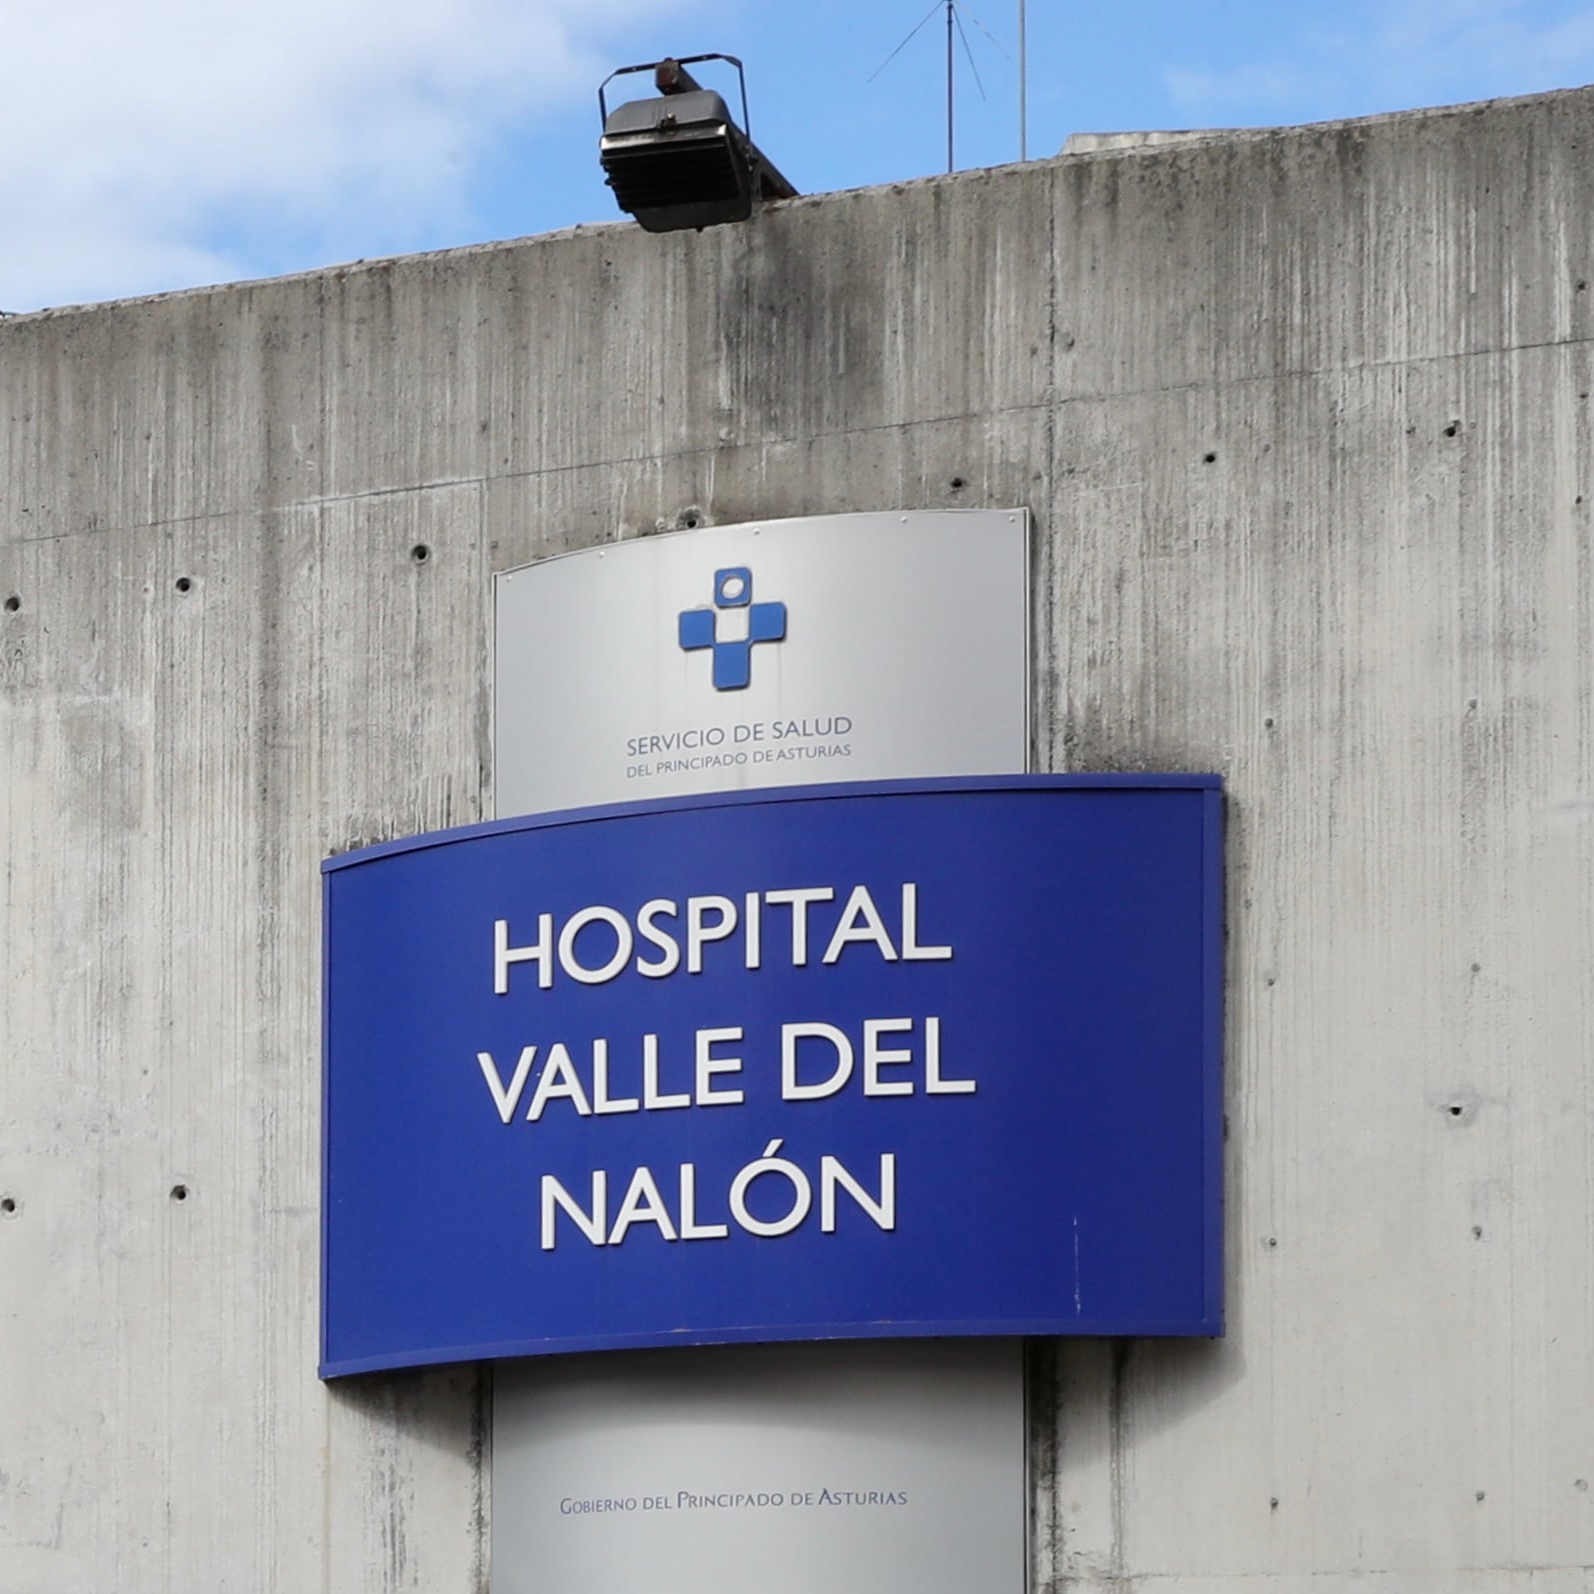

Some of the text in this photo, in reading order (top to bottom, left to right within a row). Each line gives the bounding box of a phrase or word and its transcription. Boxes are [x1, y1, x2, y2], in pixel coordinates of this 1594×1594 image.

[626, 744, 852, 779] DEL PRINCIPADO DE ASTURIAS
[627, 716, 852, 757] SERVICIO DE SALUD
[494, 883, 952, 995] HOSPITAL
[477, 1017, 976, 1124] VALLE DEL
[541, 1138, 895, 1250] NALÓN
[560, 1488, 908, 1515] GOBIERNO DEL PRINCIPADO DE ASTURIAS
